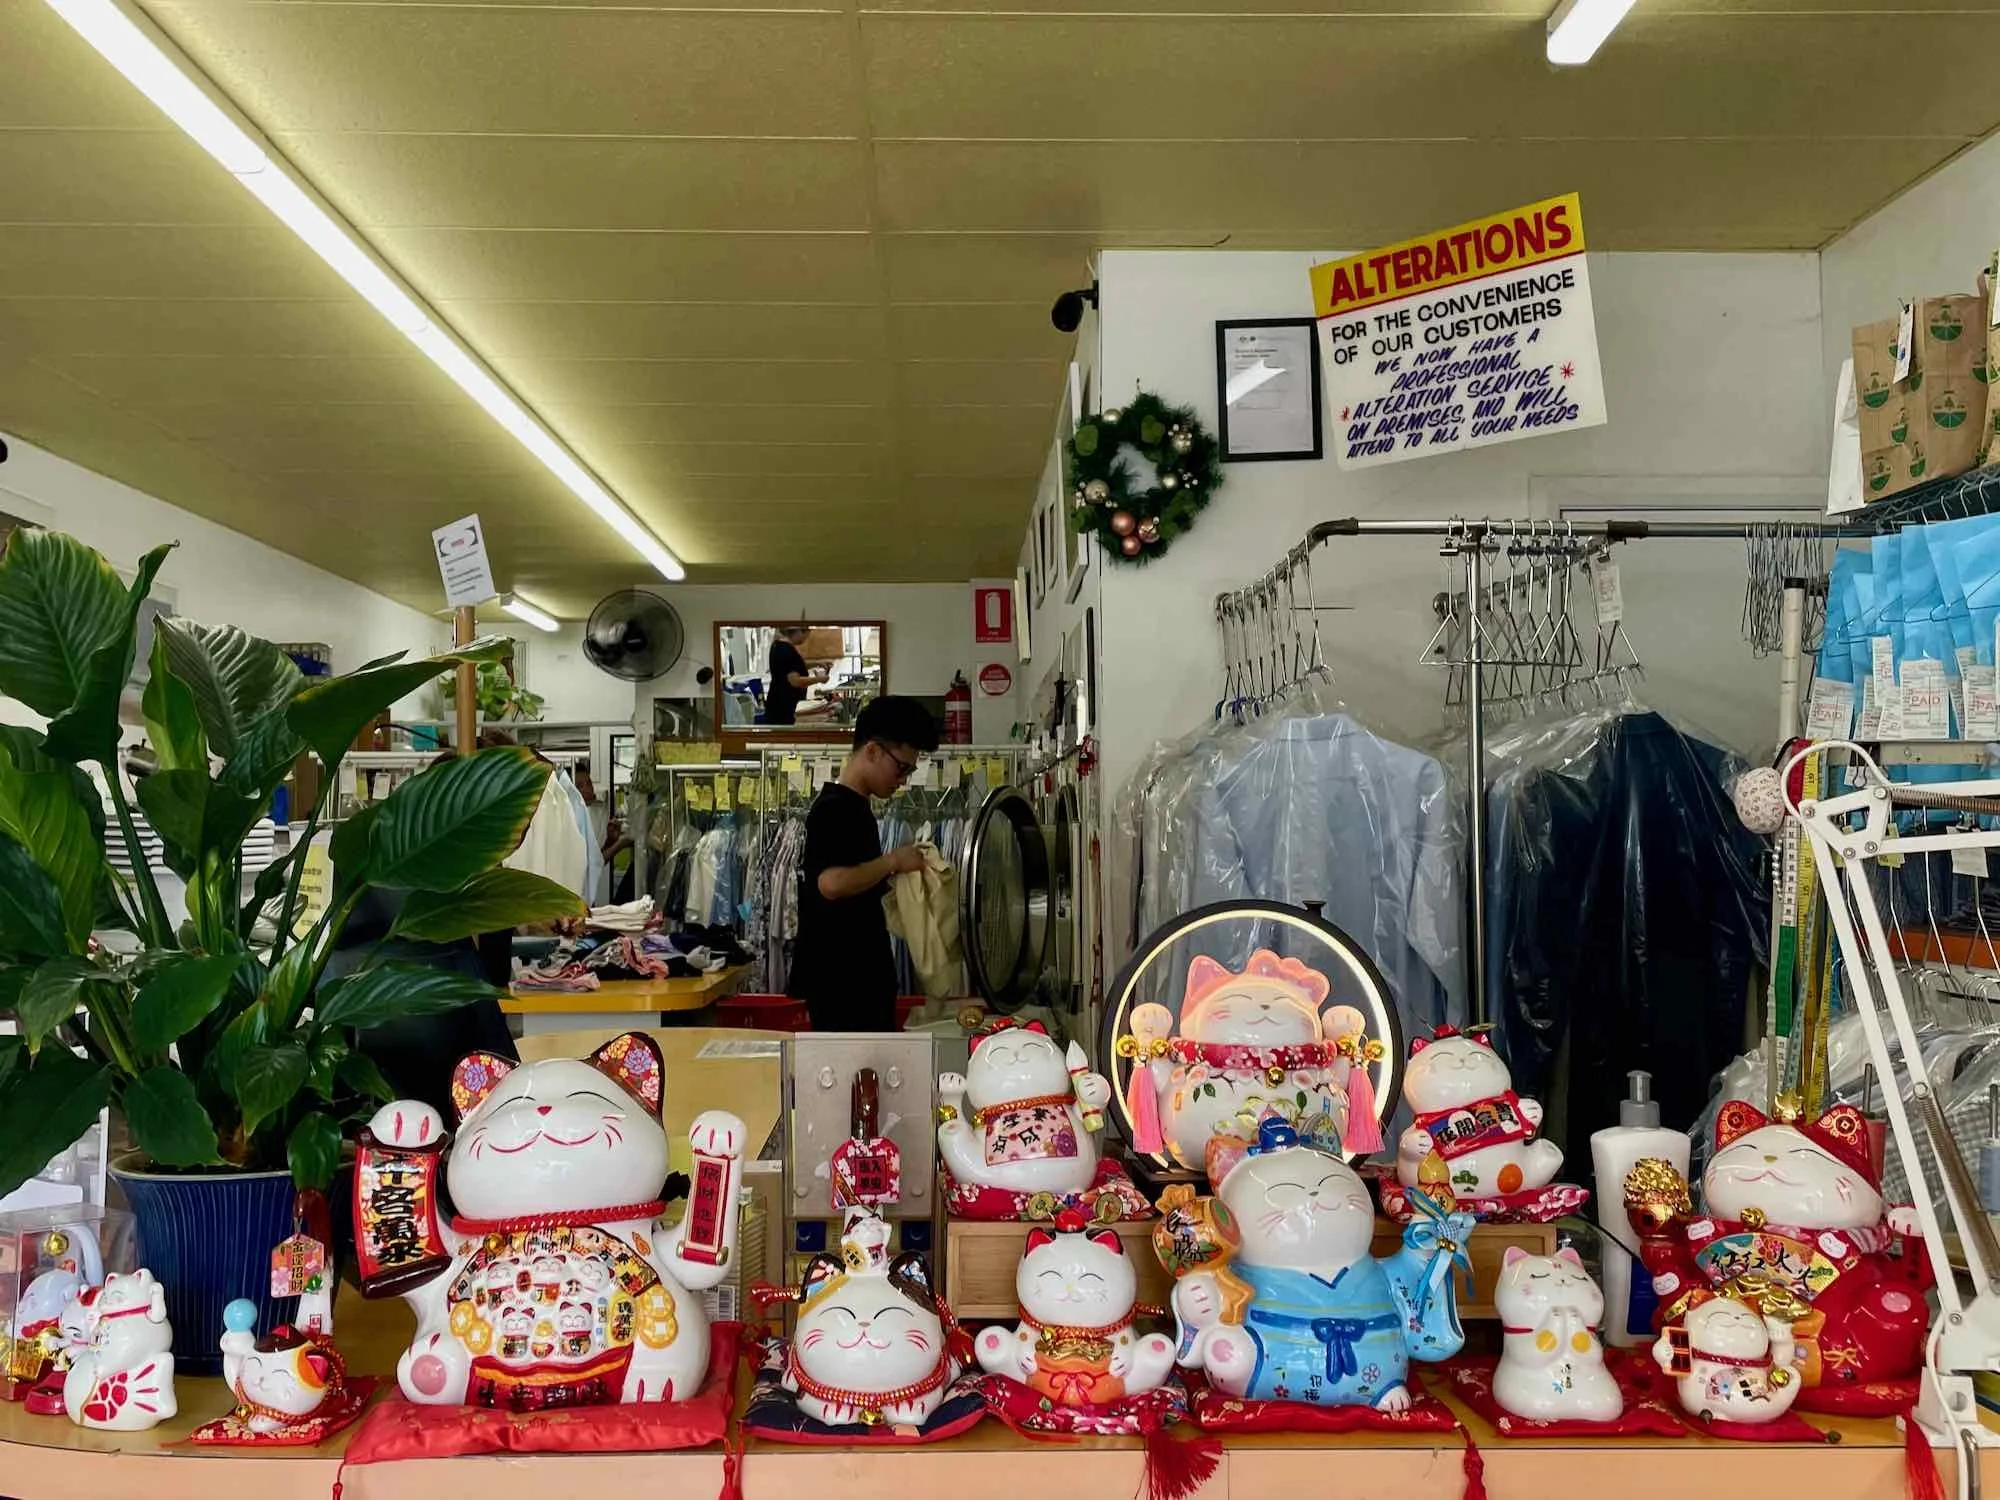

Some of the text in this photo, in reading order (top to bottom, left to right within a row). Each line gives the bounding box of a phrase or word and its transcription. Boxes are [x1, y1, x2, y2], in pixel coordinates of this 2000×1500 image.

[1329, 205, 1573, 307] ALTERATIONS
[1332, 268, 1575, 344] FOR THE CONVENIENCE
[1334, 298, 1563, 365] OF OUR CUSTOMERS
[1375, 328, 1541, 375] WE NOW HAVE A
[1390, 350, 1521, 393] PROFESSIONAL
[1347, 385, 1568, 441] ON PREMISES, AND WILL
[1353, 365, 1553, 421] ALTERATION SERVICE
[1346, 405, 1579, 459] ATTEND TO ALL YOUR NEEDS
[1912, 697, 1940, 707] PAID
